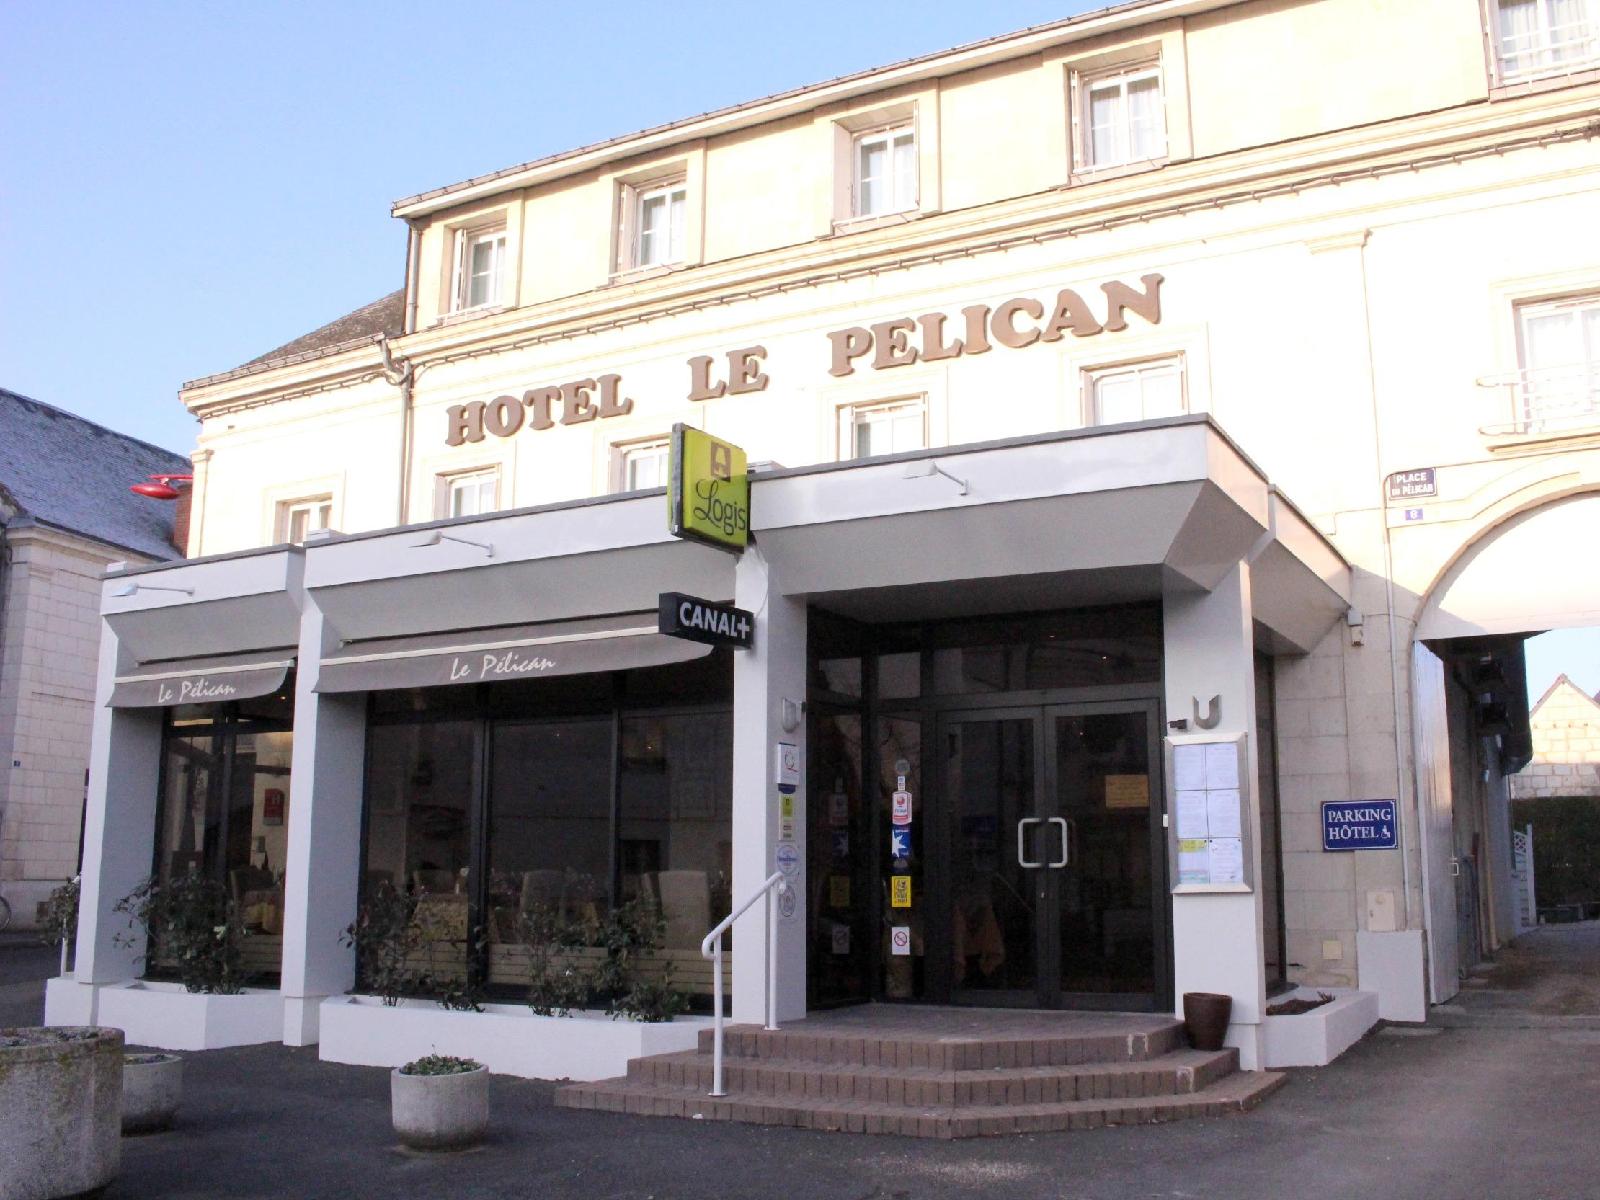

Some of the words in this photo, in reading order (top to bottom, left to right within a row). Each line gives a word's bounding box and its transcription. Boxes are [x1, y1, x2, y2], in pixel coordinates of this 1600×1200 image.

[445, 373, 633, 446] HOTEL
[687, 345, 768, 401] LE
[826, 272, 1165, 377] PELICAN
[1396, 472, 1427, 484] PLACE
[693, 479, 746, 536] Logis
[680, 601, 750, 640] CANAL+
[450, 657, 471, 680] Le
[480, 651, 557, 680] Pélican
[158, 683, 173, 703] Le
[179, 678, 237, 703] Pélican
[1328, 808, 1391, 823] PARKING
[1328, 825, 1379, 840] HÔTEL
